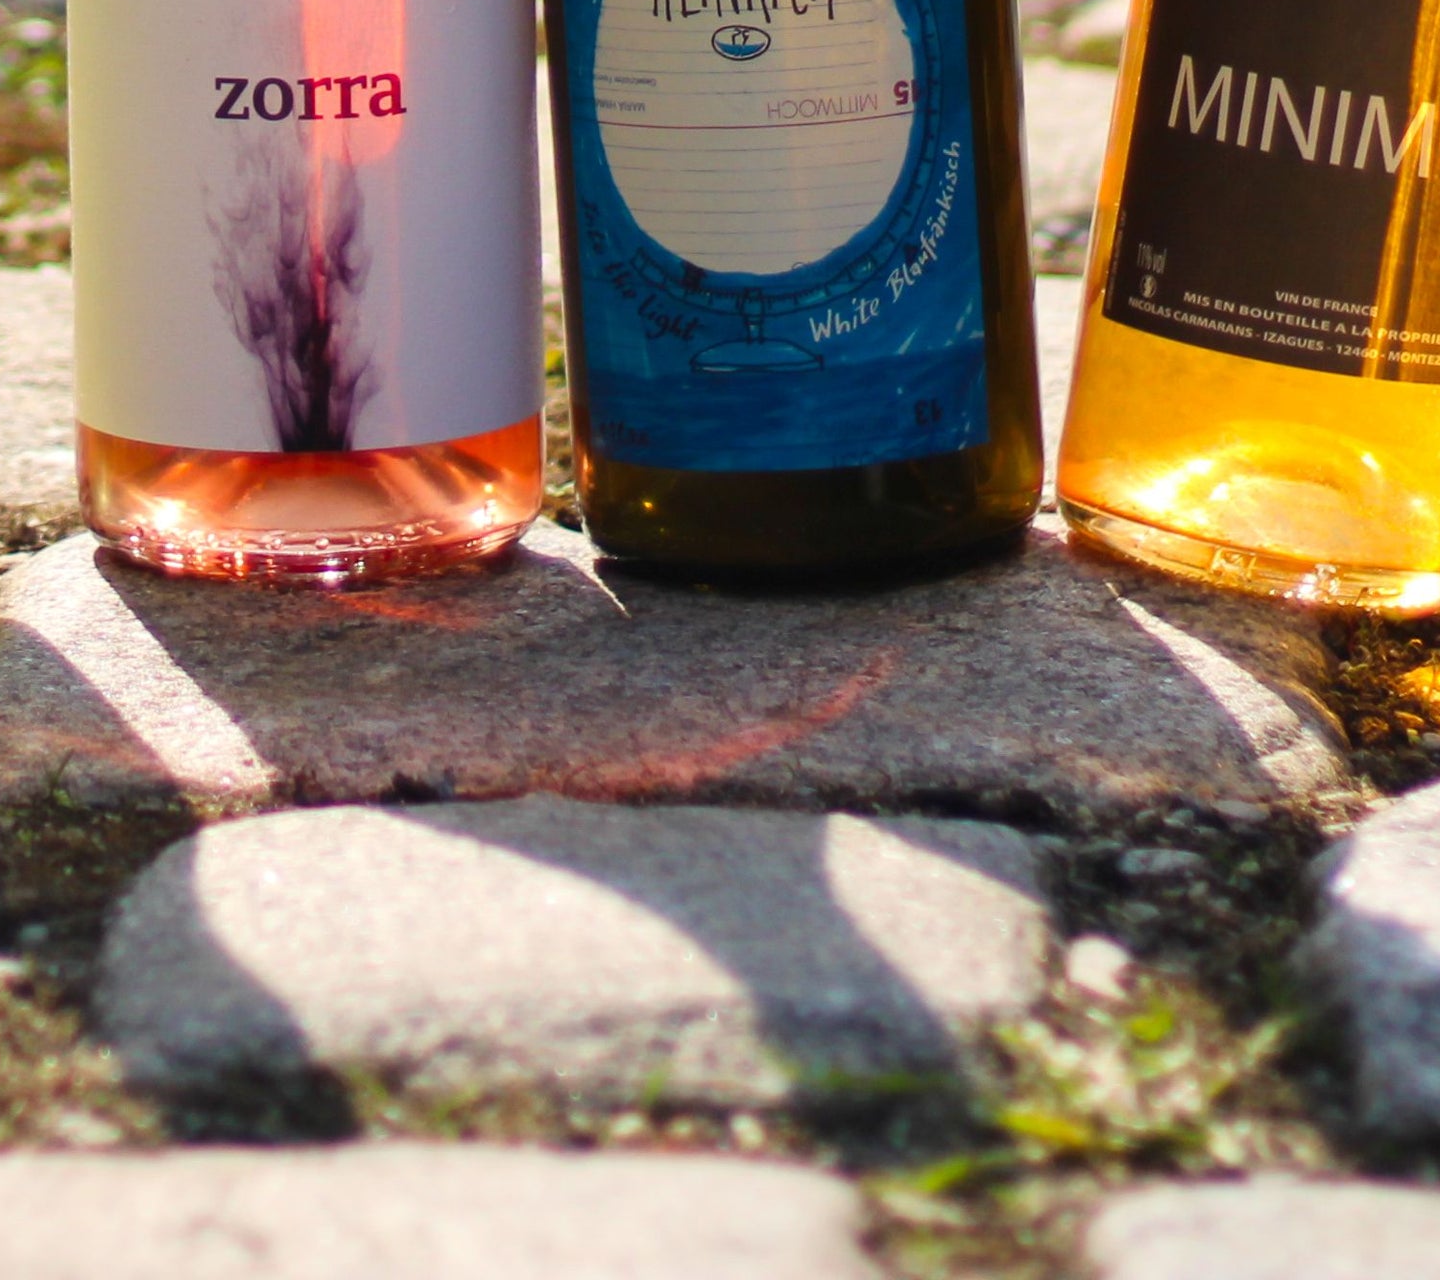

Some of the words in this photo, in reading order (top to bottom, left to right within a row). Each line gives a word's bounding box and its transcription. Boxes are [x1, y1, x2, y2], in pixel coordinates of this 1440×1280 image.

[213, 69, 408, 122] zorra
[766, 92, 880, 121] MITTWOCH
[808, 296, 881, 344] White
[1127, 296, 1171, 319] NICOLAS
[1172, 309, 1254, 340] CARMARANS
[1263, 330, 1325, 352] IZAGUES
[1183, 291, 1212, 308] MIS
[1214, 298, 1236, 313] EN
[1238, 304, 1331, 332] BOUTEILLE
[1334, 322, 1347, 335] A
[1351, 325, 1374, 339] LA
[1275, 290, 1300, 305] VIN
[1302, 295, 1322, 310] DE
[1323, 298, 1379, 318] FRANCE
